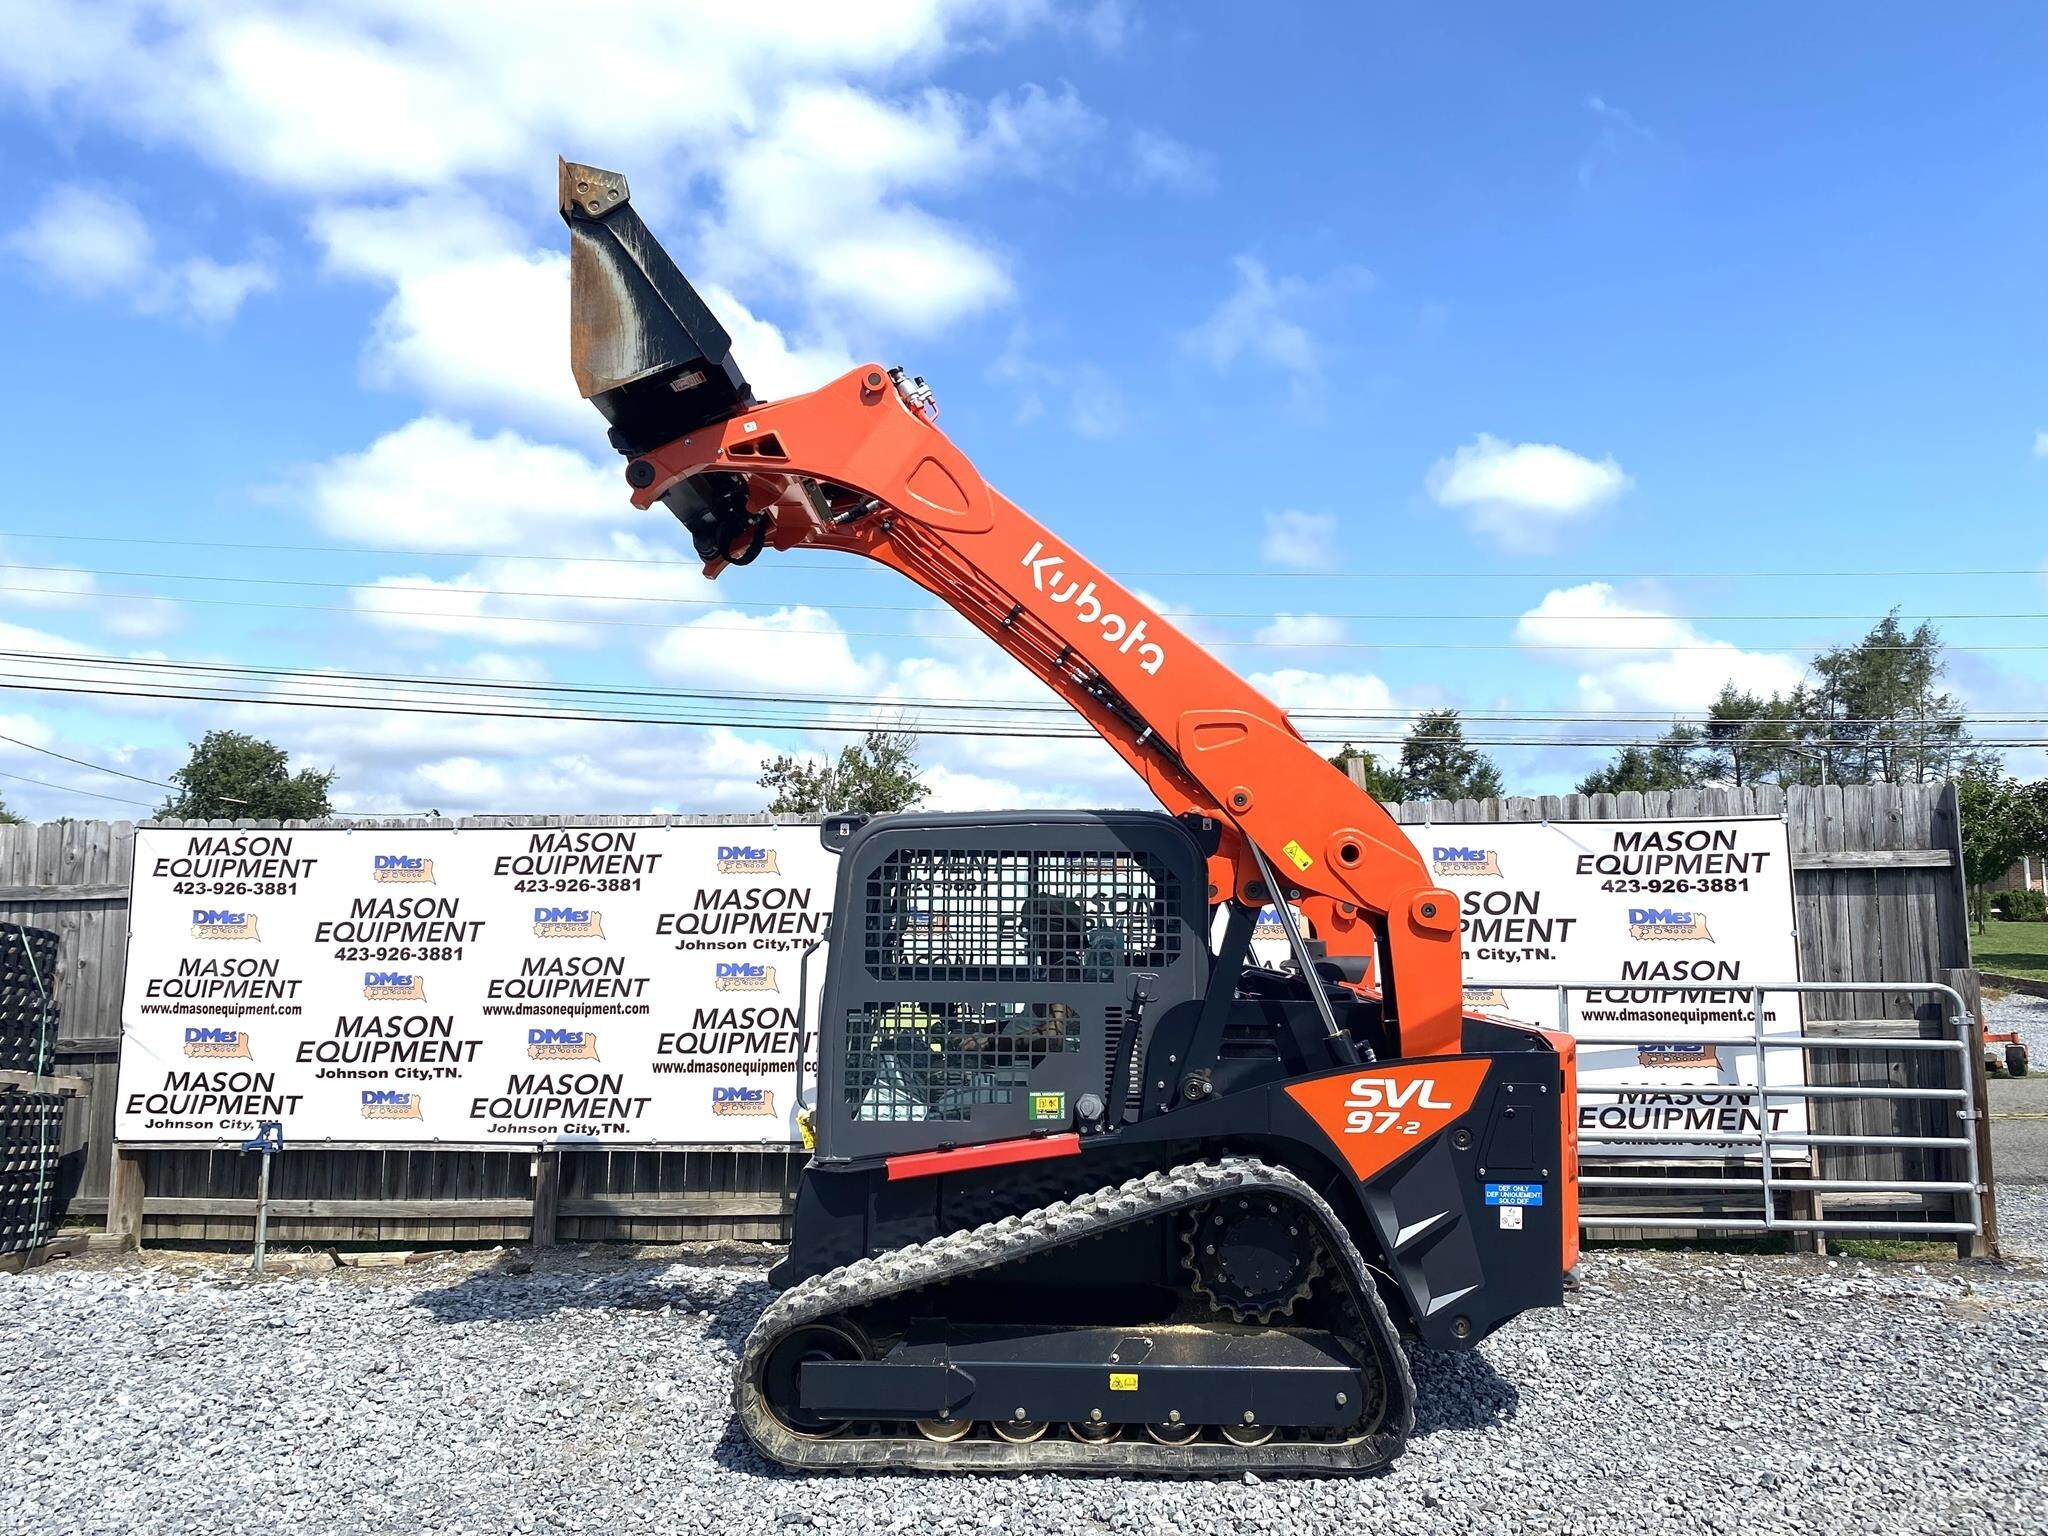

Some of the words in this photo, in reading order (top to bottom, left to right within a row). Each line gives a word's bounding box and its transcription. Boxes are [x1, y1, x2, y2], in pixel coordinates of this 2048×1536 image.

[1021, 541, 1165, 676] Kubota
[188, 837, 292, 856] MASON
[529, 833, 636, 852] MASON
[1614, 830, 1736, 851] MASON
[153, 858, 317, 878] EQUIPMENT
[494, 854, 662, 875] EQUIPMENT
[1576, 853, 1770, 875] EQUIPMENT
[173, 882, 296, 895] 423-926-3881
[515, 879, 640, 892] 423-926-3881
[1601, 878, 1748, 893] 423-926-3881
[351, 898, 459, 918] MASON
[694, 888, 810, 910] MASON
[1462, 891, 1540, 915] SON
[315, 922, 485, 942] EQUIPMENT
[656, 912, 832, 935] EQUIPMENT
[1461, 919, 1577, 942] PMENT
[335, 947, 462, 960] 423-926-3881
[676, 940, 746, 950] Johnson
[1478, 949, 1555, 962] City,TN.
[1478, 949, 1556, 963] City,TN.
[179, 959, 279, 977] MASON
[521, 957, 624, 976] MASON
[1622, 961, 1740, 980] MASON
[146, 979, 302, 998] EQUIPMENT
[488, 979, 650, 998] EQUIPMENT
[141, 1002, 301, 1017] www.dmasonequipment.com
[483, 1003, 649, 1016] www.dmasonequipment.com
[693, 1008, 799, 1029] MASON
[1582, 1008, 1777, 1025] www.dmasonequipment.cm
[335, 1016, 453, 1038] MASON
[296, 1041, 483, 1063] EQUIPMENT
[164, 1072, 275, 1092] MASON
[316, 1068, 388, 1078] Johnson
[395, 1068, 461, 1080] City,TN.
[507, 1074, 623, 1095] MASON
[1343, 1078, 1452, 1110] SVL
[126, 1094, 303, 1114] EQUIPMENT
[470, 1098, 651, 1118] EQUIPMENT
[145, 1119, 213, 1128] Johnson
[1343, 1111, 1420, 1135] 97-2
[1578, 1107, 1788, 1131] EQUIPMENT
[488, 1124, 557, 1133] Johnson
[564, 1124, 629, 1136] City,TN.
